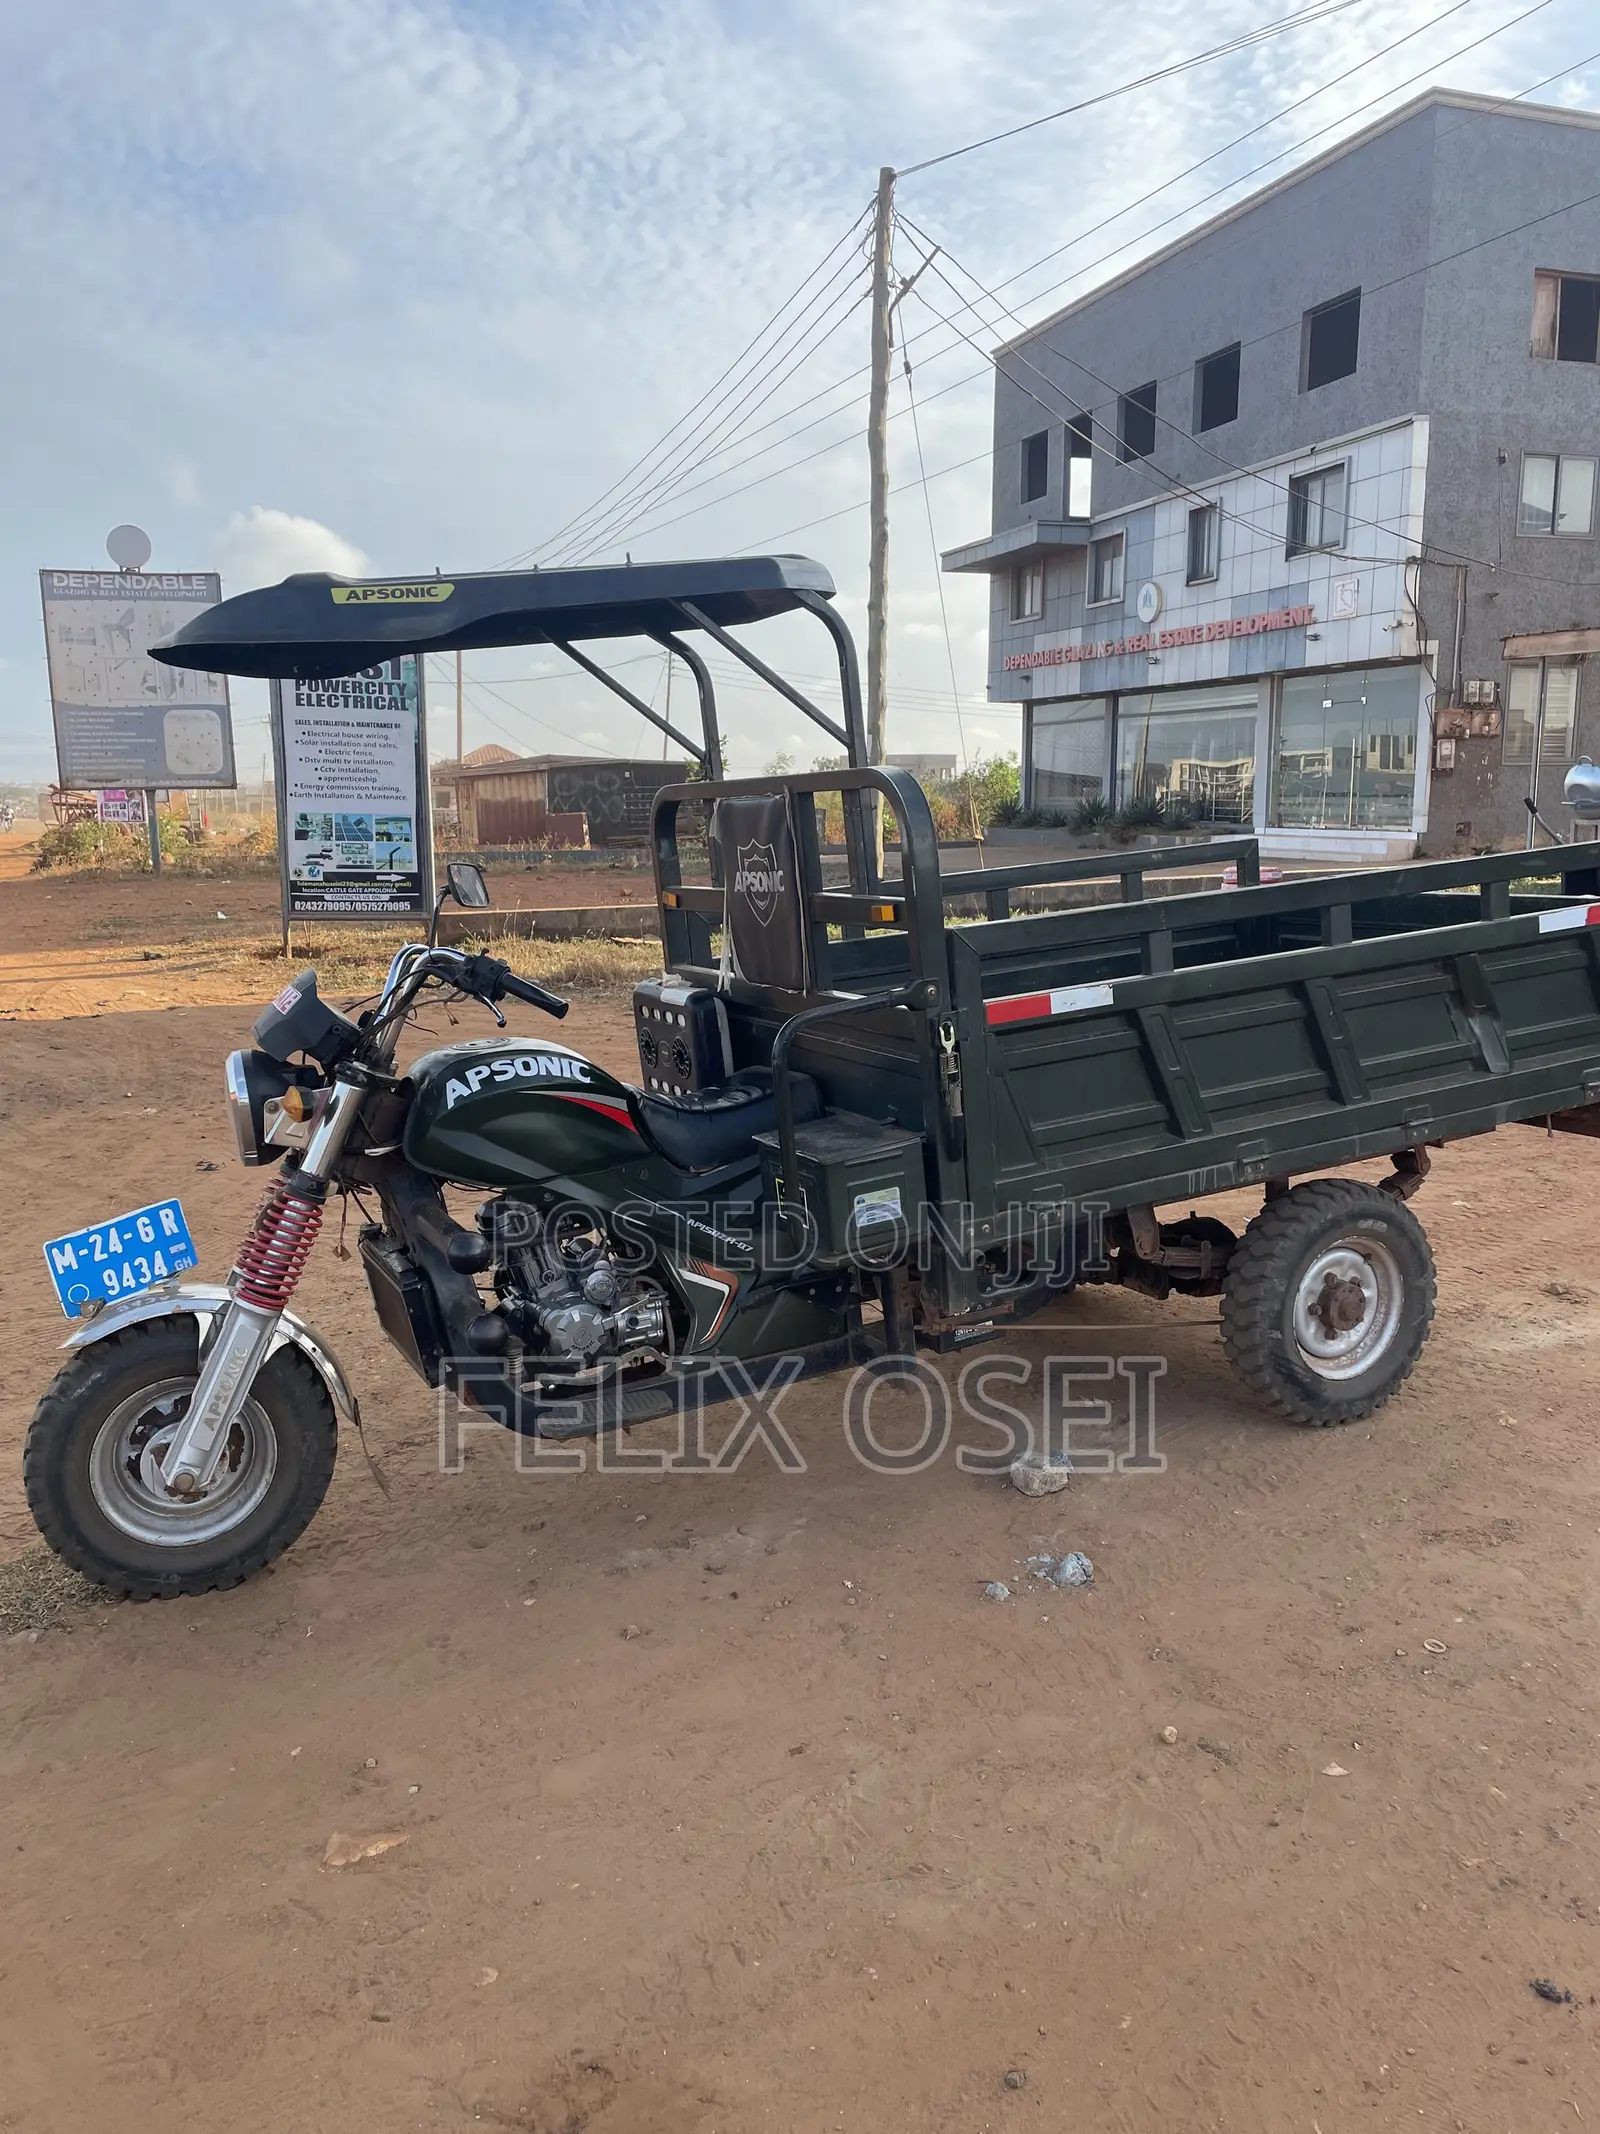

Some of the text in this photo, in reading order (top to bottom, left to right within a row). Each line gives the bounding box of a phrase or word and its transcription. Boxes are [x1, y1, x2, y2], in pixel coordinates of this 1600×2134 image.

[53, 572, 207, 590] DEPENDABLE
[53, 588, 90, 596] GLAZING
[345, 586, 439, 602] APSONIC
[1004, 647, 1063, 671] DEPENDABLE
[1063, 640, 1115, 662] GLAZING
[1115, 639, 1125, 654] &
[1127, 632, 1158, 653] REAL
[1159, 624, 1204, 649] ESTATE
[295, 679, 409, 697] POWERCITY
[295, 692, 409, 711] ELECTRICAL
[313, 720, 350, 728] INSTALLATION
[356, 721, 393, 729] MAINTENANCE
[307, 730, 340, 738] Electrical
[341, 731, 364, 739] house
[320, 740, 361, 748] installation
[324, 748, 351, 756] Electric
[320, 765, 336, 773] Cctv
[323, 775, 377, 784] apprenticeship
[300, 783, 325, 791] Energy
[294, 791, 313, 799] Earth
[314, 792, 354, 800] Installation
[734, 869, 785, 892] APSONIC
[295, 900, 411, 911] 0243279095/0575279095
[445, 1055, 592, 1110] APSONIC
[174, 1256, 193, 1271] GH
[102, 1250, 168, 1296] 9434
[203, 1345, 249, 1432] APSONIC
